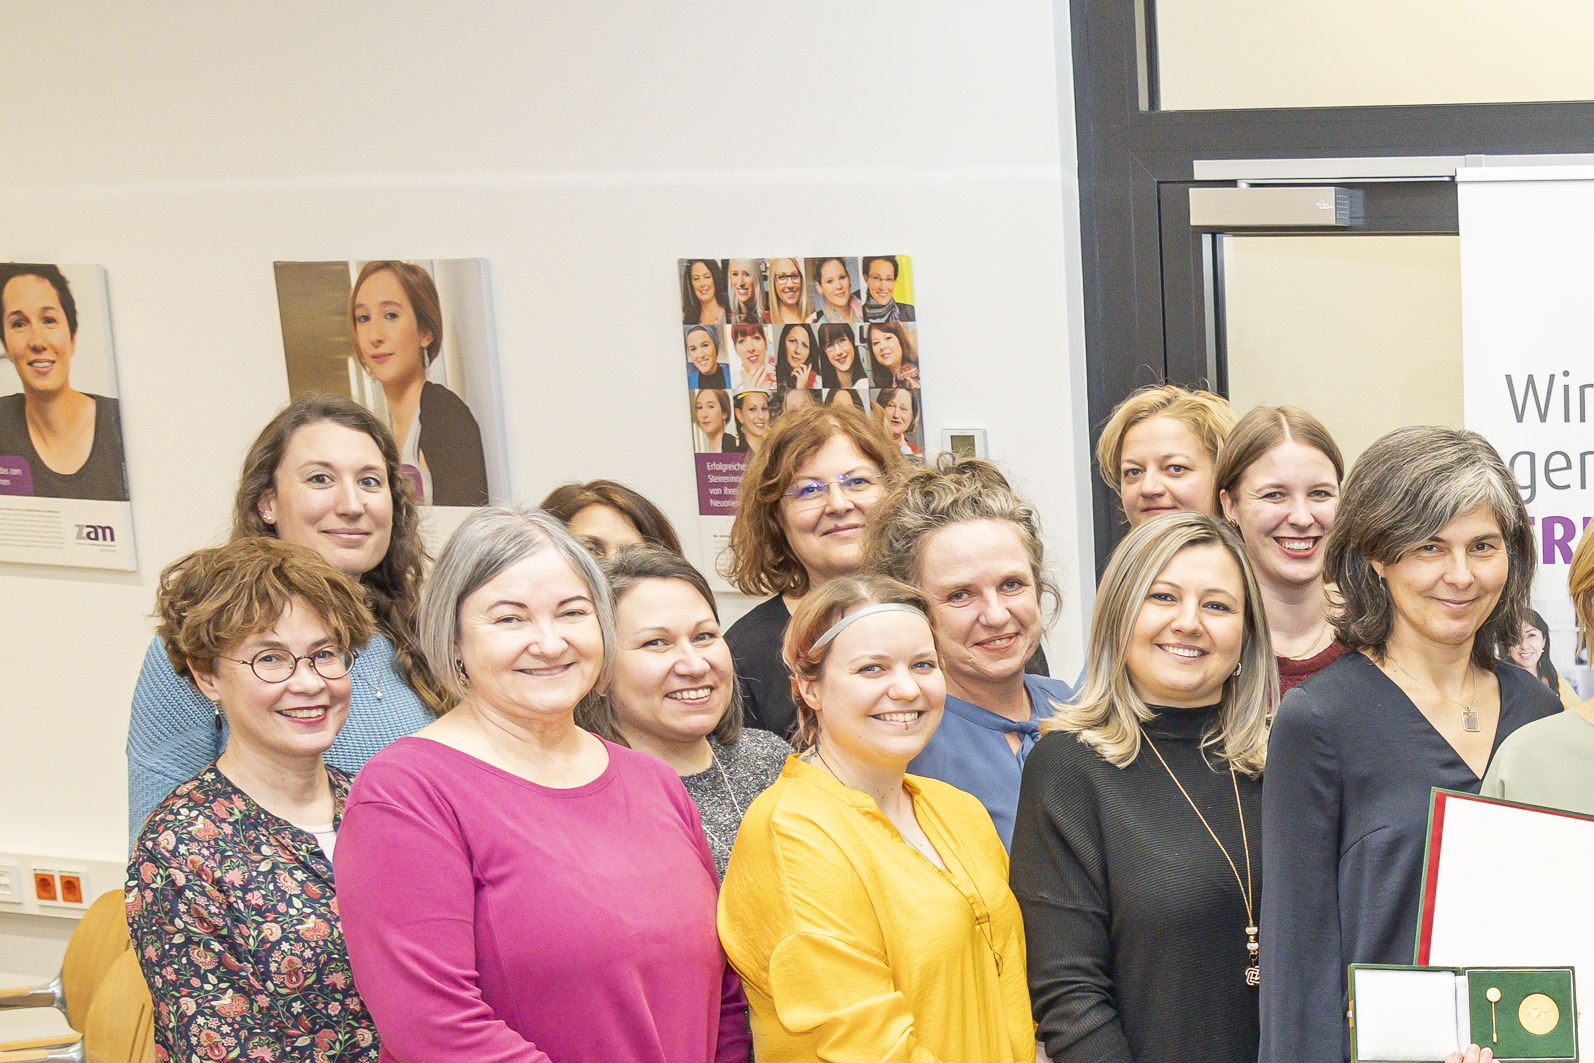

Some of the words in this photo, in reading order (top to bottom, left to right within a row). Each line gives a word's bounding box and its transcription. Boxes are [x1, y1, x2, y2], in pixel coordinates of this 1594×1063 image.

[1505, 370, 1594, 423] Wir
[708, 487, 722, 495] von
[75, 524, 115, 541] zam
